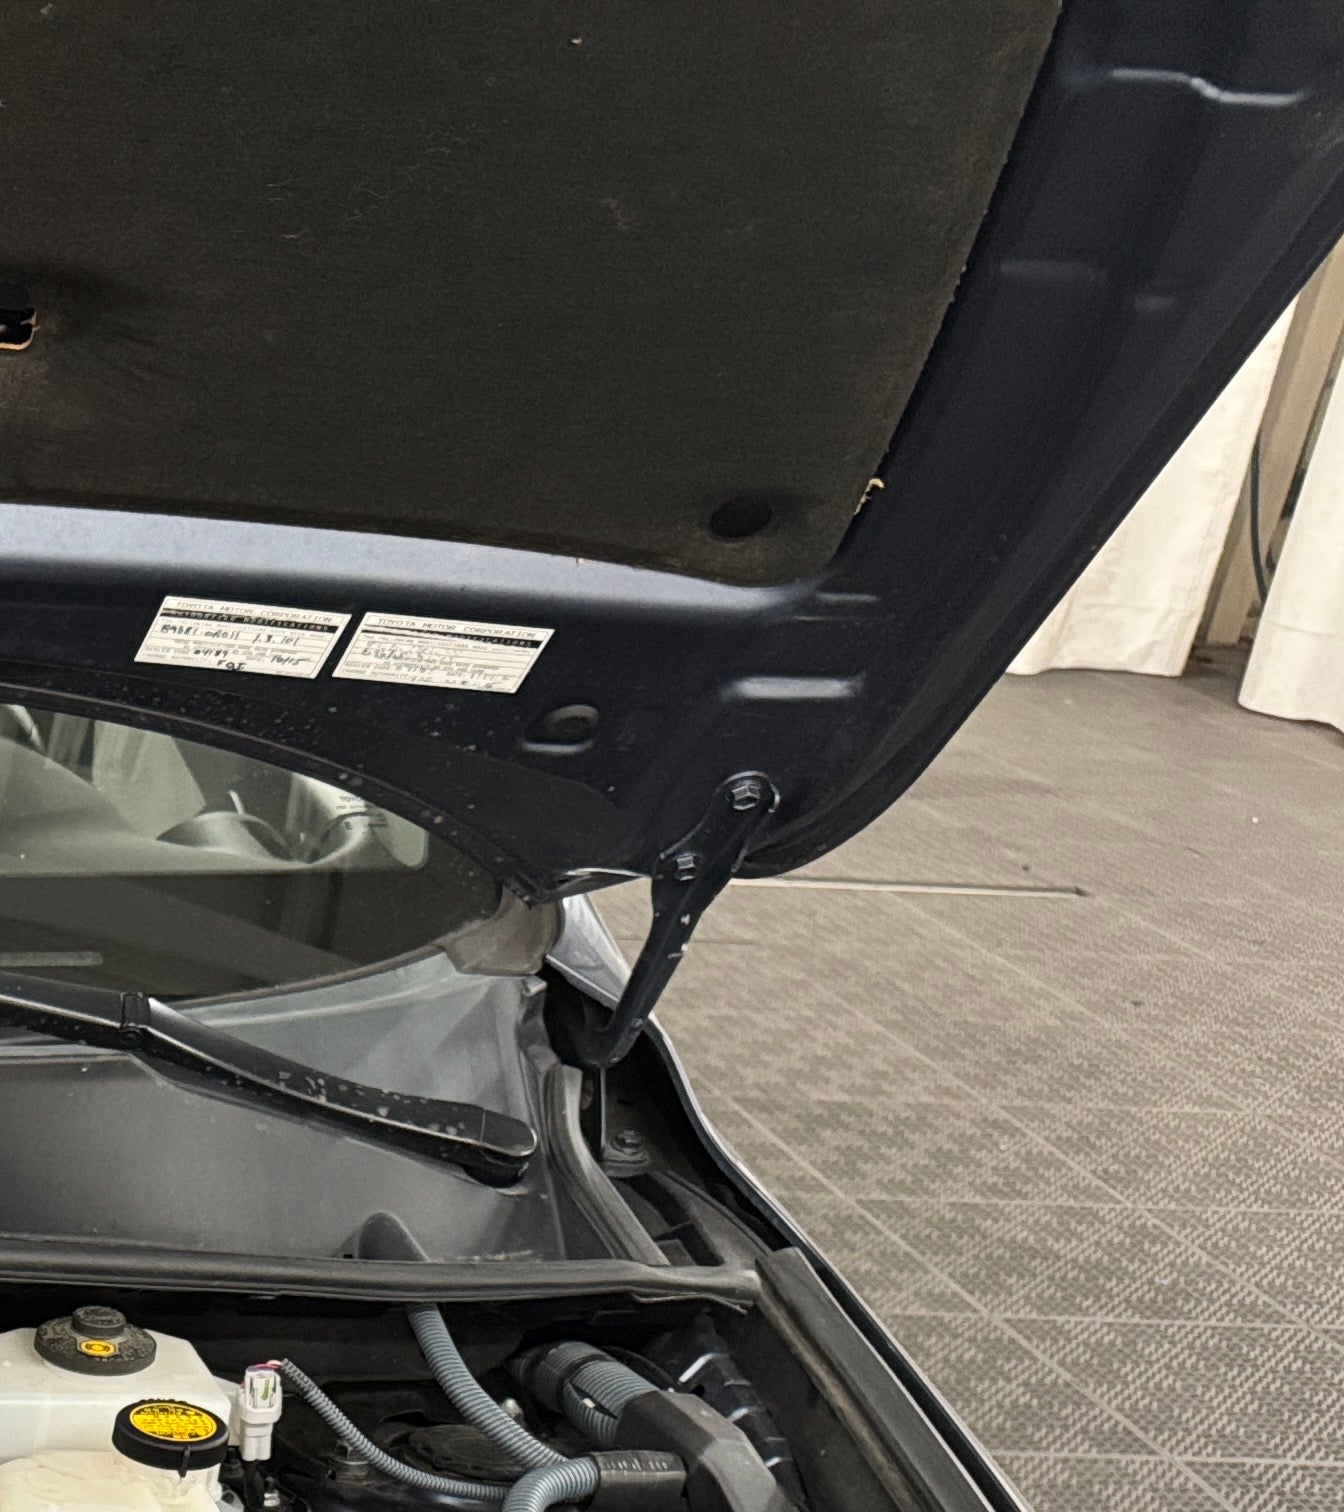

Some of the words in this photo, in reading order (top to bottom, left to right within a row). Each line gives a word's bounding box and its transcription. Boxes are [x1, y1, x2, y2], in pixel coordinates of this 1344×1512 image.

[176, 601, 215, 611] TOYOTA
[219, 603, 255, 616] MOTOR
[260, 608, 333, 623] CORPORATION
[377, 618, 416, 628] TOYOTA
[421, 621, 457, 632] MOTOR
[463, 625, 537, 639] CORPORATION
